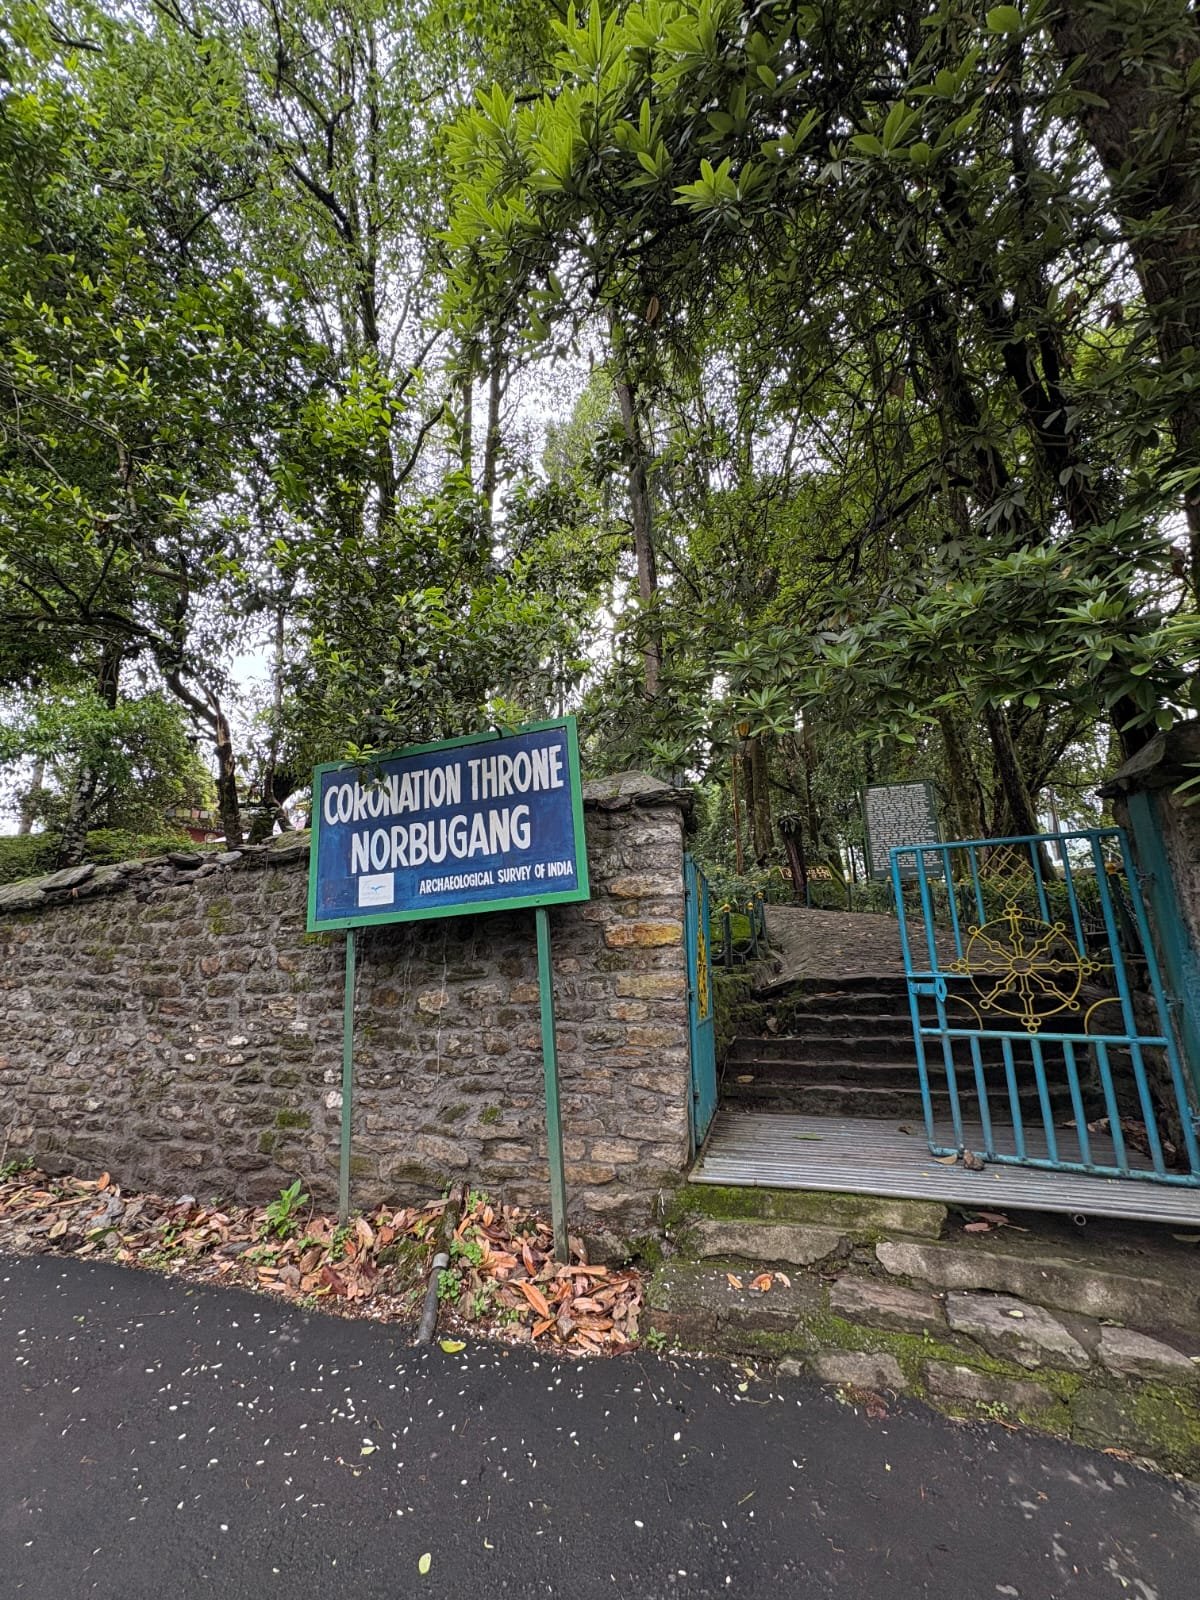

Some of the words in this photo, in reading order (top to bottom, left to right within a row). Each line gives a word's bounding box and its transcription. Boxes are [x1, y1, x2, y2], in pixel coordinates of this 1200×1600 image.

[324, 763, 461, 826] CORONATION
[468, 745, 564, 801] THRONE
[351, 804, 531, 874] NORBUGANG
[419, 872, 494, 895] ARCHAEOLOGICAL
[498, 866, 531, 883] SURVEY
[534, 863, 545, 878] OF
[547, 860, 573, 876] INDIA
